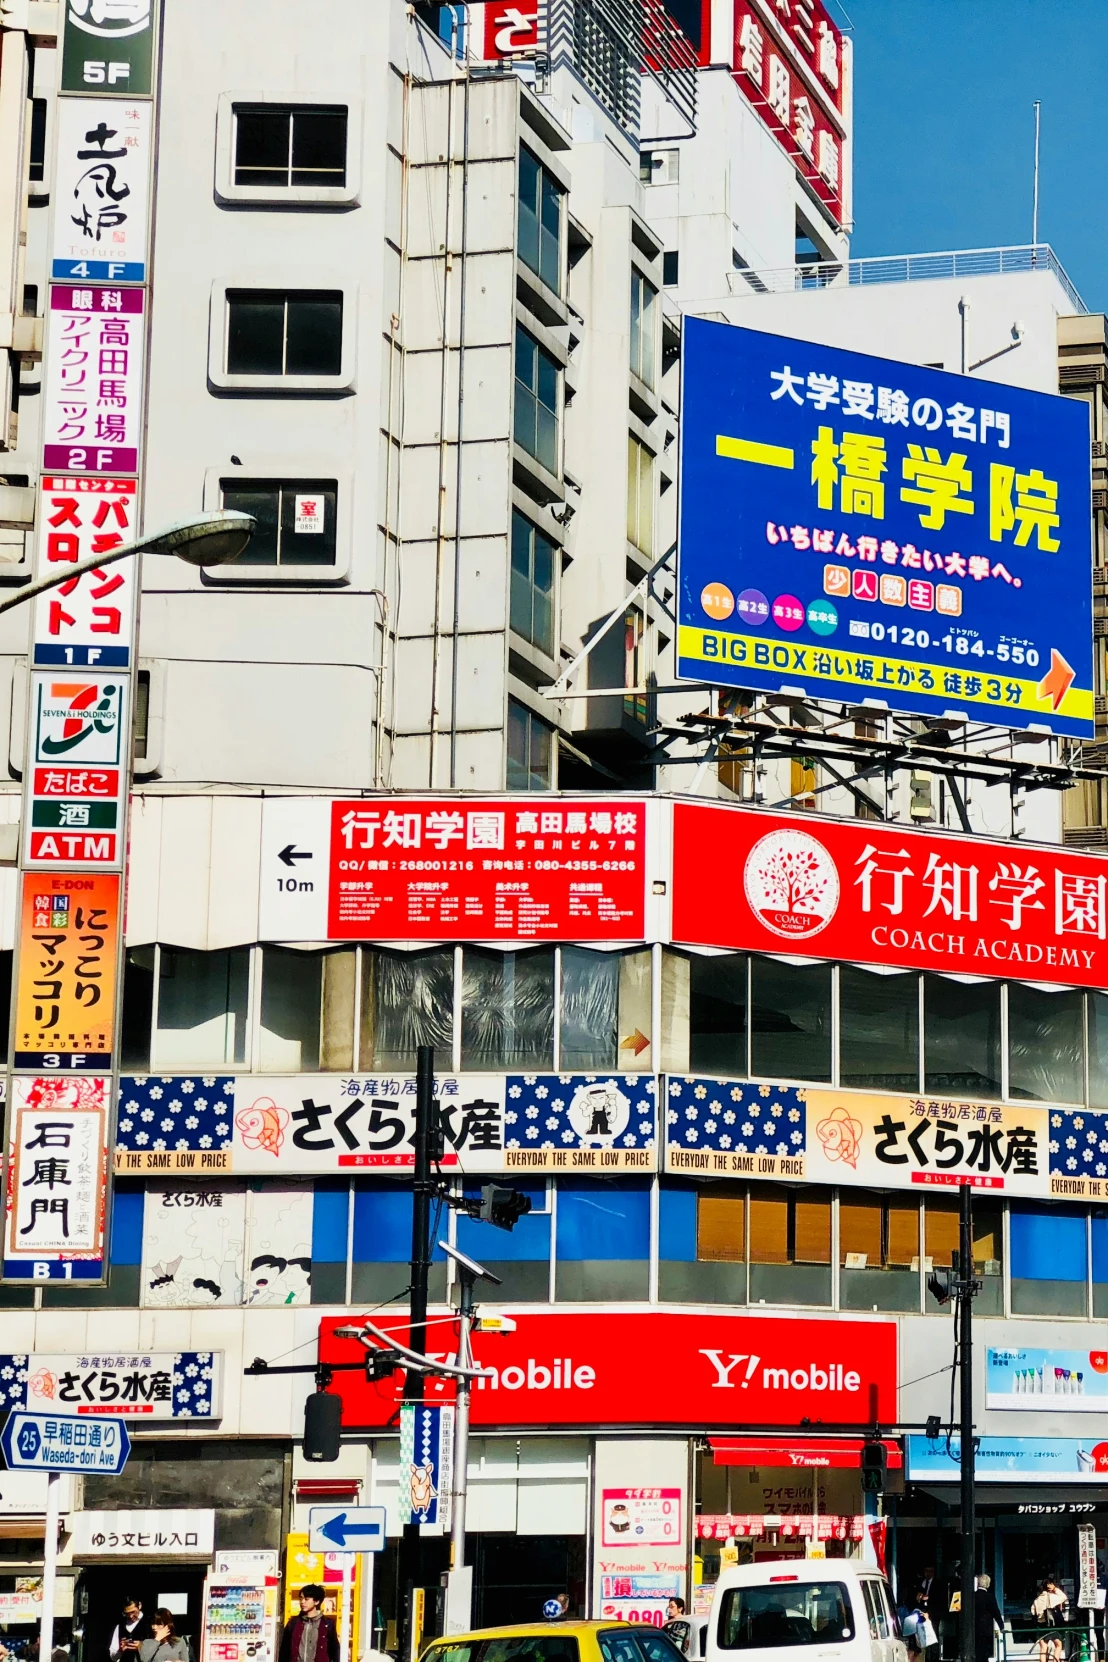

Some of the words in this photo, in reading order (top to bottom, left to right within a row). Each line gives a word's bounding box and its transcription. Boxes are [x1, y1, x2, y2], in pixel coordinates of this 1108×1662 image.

[83, 60, 131, 84] 5F
[67, 245, 127, 258] Tofuro
[71, 290, 123, 311] 眼科
[56, 315, 92, 441] アイクリニック
[94, 316, 131, 443] 高田馬場
[769, 366, 1010, 449] 大学受験の名門
[715, 425, 1061, 553] 一橋学院
[766, 521, 1023, 589] いちばん行きたい大学へ。
[826, 566, 962, 614] 少人数主義
[871, 622, 1040, 667] 0120-184-550
[702, 635, 747, 661] BIG
[754, 643, 807, 671] BOX
[813, 651, 935, 690] 沿い坂上がる
[944, 671, 1023, 704] 徒歩3分
[77, 709, 117, 719] HOLDINGS
[43, 771, 109, 795] たばこ
[58, 803, 91, 826] 酒
[515, 812, 637, 835] 高田馬場校
[340, 810, 505, 850] 行知学園
[37, 836, 110, 858] ATM
[52, 880, 94, 890] E-DON
[277, 878, 314, 892] 10m
[853, 843, 1107, 941] 行知学園
[775, 914, 811, 926] COACH
[75, 907, 109, 1007] にっこり
[871, 926, 965, 956] COACH
[977, 939, 1096, 970] ACADEMY
[32, 934, 67, 1029] マッコリ
[909, 1098, 1003, 1124] 海産物居酒屋
[873, 1114, 1039, 1176] さくら水産
[127, 1154, 143, 1168] THE
[147, 1154, 171, 1168] SAME
[176, 1154, 195, 1168] LOW
[202, 1154, 227, 1168] PRICE
[507, 1151, 548, 1167] EVERYDAY
[552, 1152, 567, 1167] THE
[571, 1152, 595, 1167] SAME
[601, 1152, 620, 1167] LOW
[624, 1152, 650, 1167] PRICE
[670, 1153, 709, 1169] EVERYDAY
[713, 1154, 728, 1170] THE
[732, 1155, 754, 1172] SAME
[758, 1157, 776, 1173] LOW
[780, 1158, 804, 1176] PRICE
[20, 1123, 75, 1238] 石庫門
[1051, 1178, 1085, 1195] EVERYDAY
[1088, 1180, 1101, 1196] THE
[162, 1190, 223, 1208] さくら水産
[33, 1262, 73, 1280] B1
[76, 1357, 152, 1369] 海産物居酒屋
[58, 1371, 172, 1402] さくら水産
[22, 1433, 37, 1451] 25
[43, 1421, 116, 1447] 早稲田通り
[42, 1446, 96, 1465] Waseda-dori
[1018, 1503, 1066, 1514] タバコショップ
[91, 1531, 199, 1547] ゆう文ビル入口
